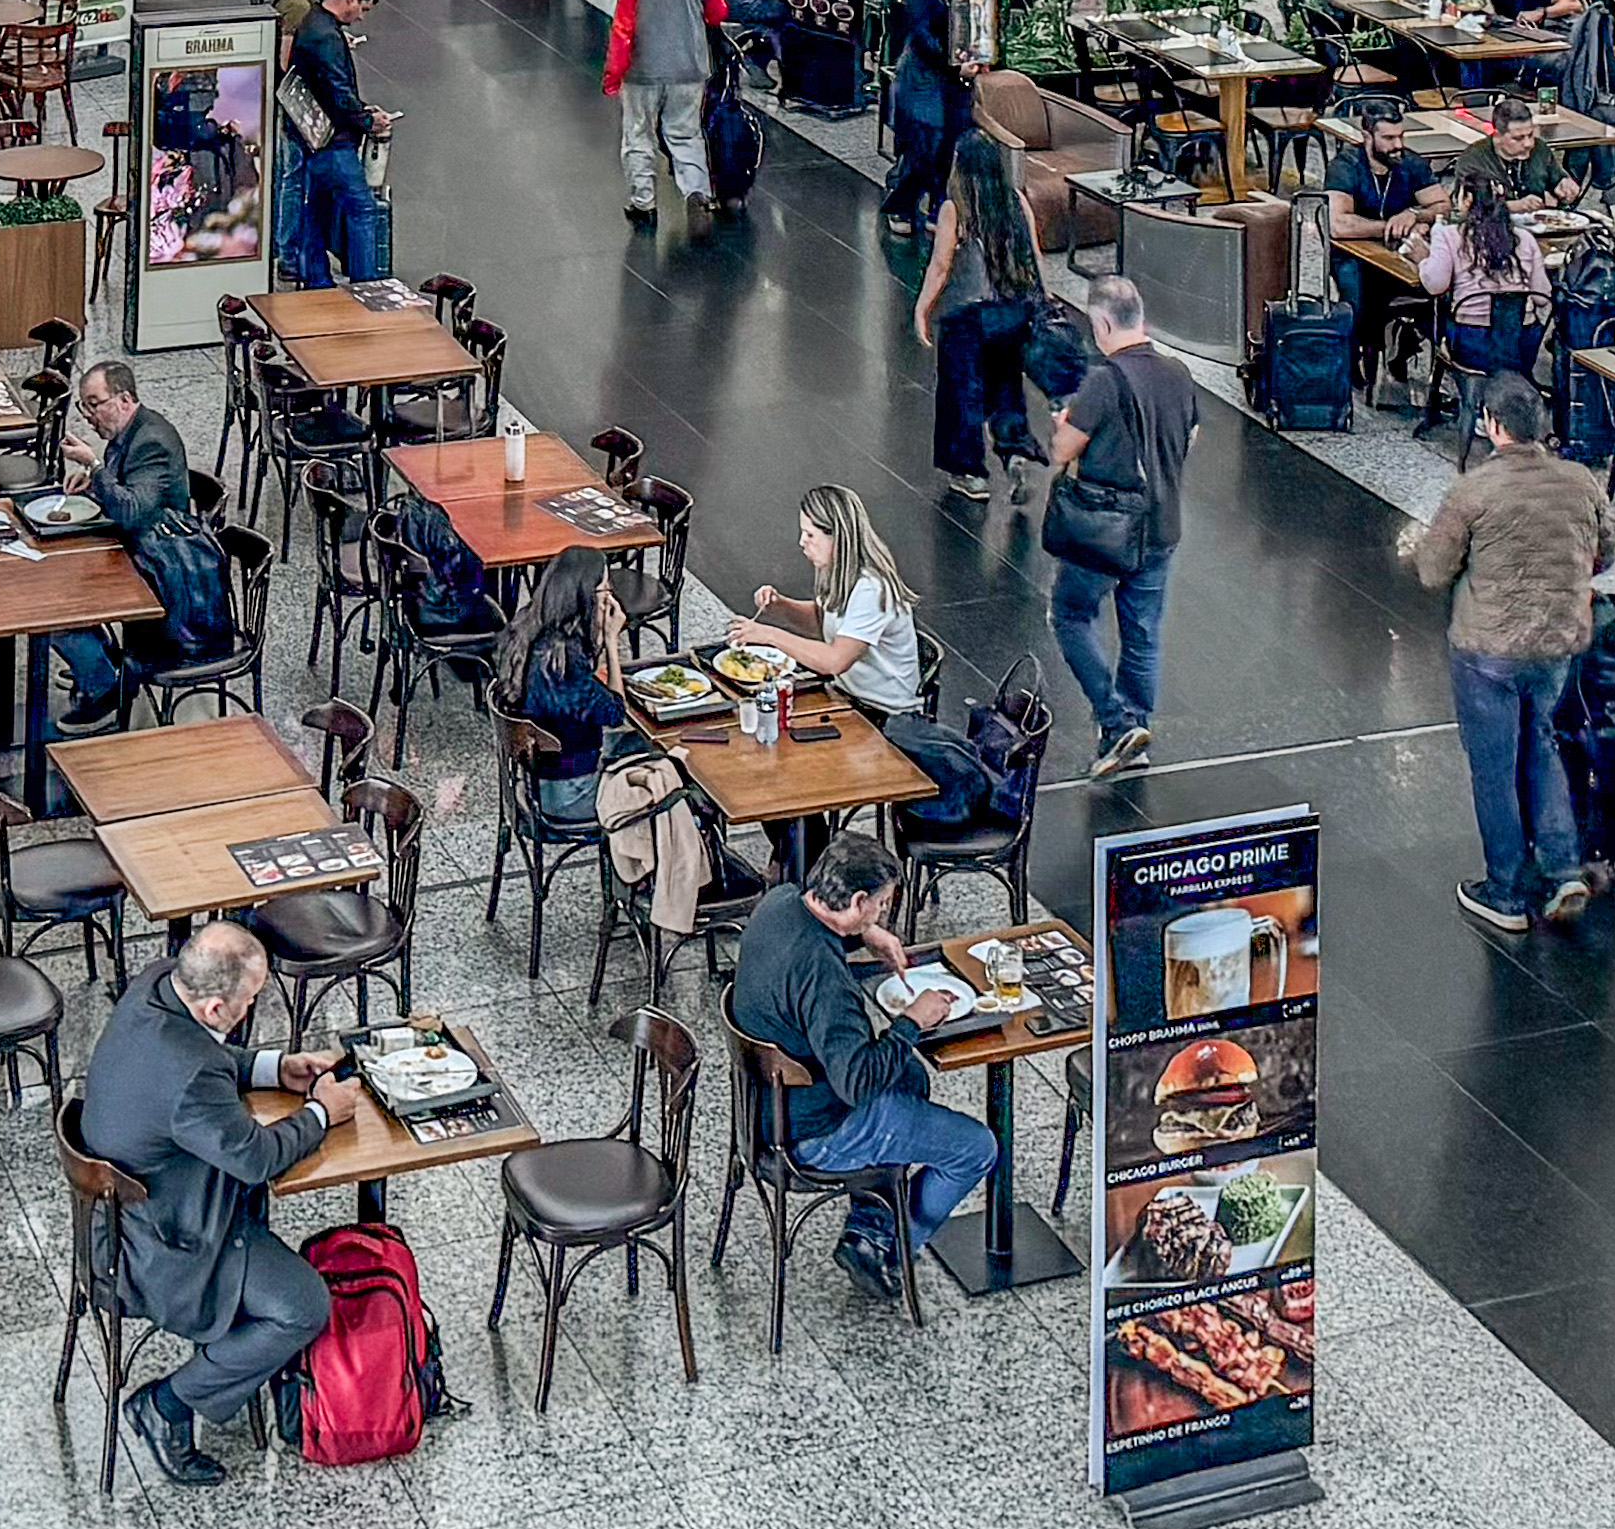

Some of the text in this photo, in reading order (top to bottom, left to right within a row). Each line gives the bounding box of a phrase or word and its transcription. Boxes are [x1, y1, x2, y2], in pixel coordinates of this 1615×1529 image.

[185, 36, 234, 54] BRAHMA
[1134, 843, 1289, 885] CHICAGO PRIME
[1108, 1032, 1146, 1049] CHOPP
[1148, 1022, 1196, 1042] BRAHMA
[1107, 1154, 1203, 1184] CHICAGO BURGER
[1183, 1283, 1219, 1303] BLACK
[1221, 1275, 1259, 1294] ANGUS
[1106, 1413, 1231, 1454] ESPETINHO DE FRANGO
